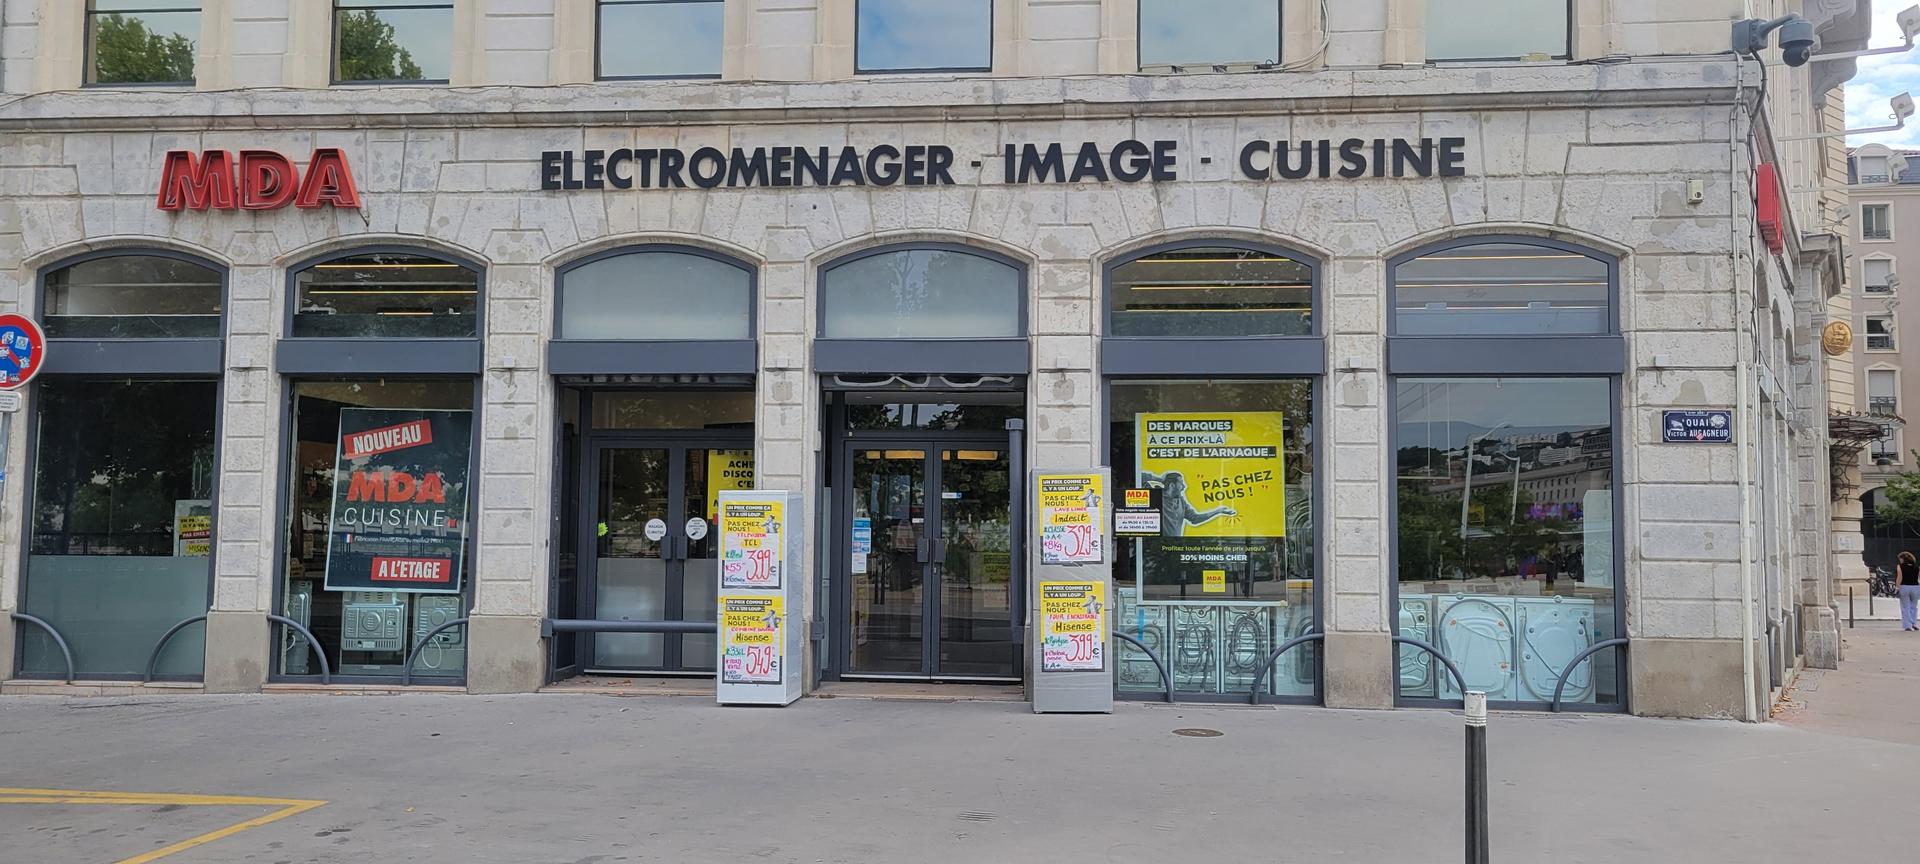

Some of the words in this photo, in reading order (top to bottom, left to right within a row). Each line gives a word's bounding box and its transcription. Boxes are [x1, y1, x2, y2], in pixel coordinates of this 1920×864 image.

[541, 144, 956, 190] ELECTROMENAGER
[1004, 140, 1177, 184] IMAGE
[1239, 136, 1466, 180] CUISINE
[157, 148, 362, 212] MDA
[1148, 421, 1171, 431] DES
[1174, 421, 1231, 431] MARQUES
[1686, 418, 1708, 427] QUAI
[352, 424, 422, 455] NOUVEAU
[1149, 433, 1157, 444] À
[1160, 435, 1176, 444] CE
[1178, 433, 1223, 444] PRIX-LÀ
[1149, 447, 1181, 457] C'EST
[1184, 447, 1200, 457] DE
[346, 470, 446, 504] MDA
[1234, 470, 1273, 486] CHEZ
[1203, 488, 1245, 503] NOUS
[344, 507, 446, 527] CUISINE
[1055, 514, 1088, 523] Indesit
[1064, 525, 1092, 557] 329
[1091, 540, 1098, 548] €
[378, 561, 388, 577] A
[390, 561, 441, 579] L'ETAGE
[746, 549, 771, 581] 399
[1056, 622, 1092, 631] Hisense
[736, 632, 769, 641] Hisense
[1065, 633, 1093, 662] 399
[746, 645, 771, 675] 549
